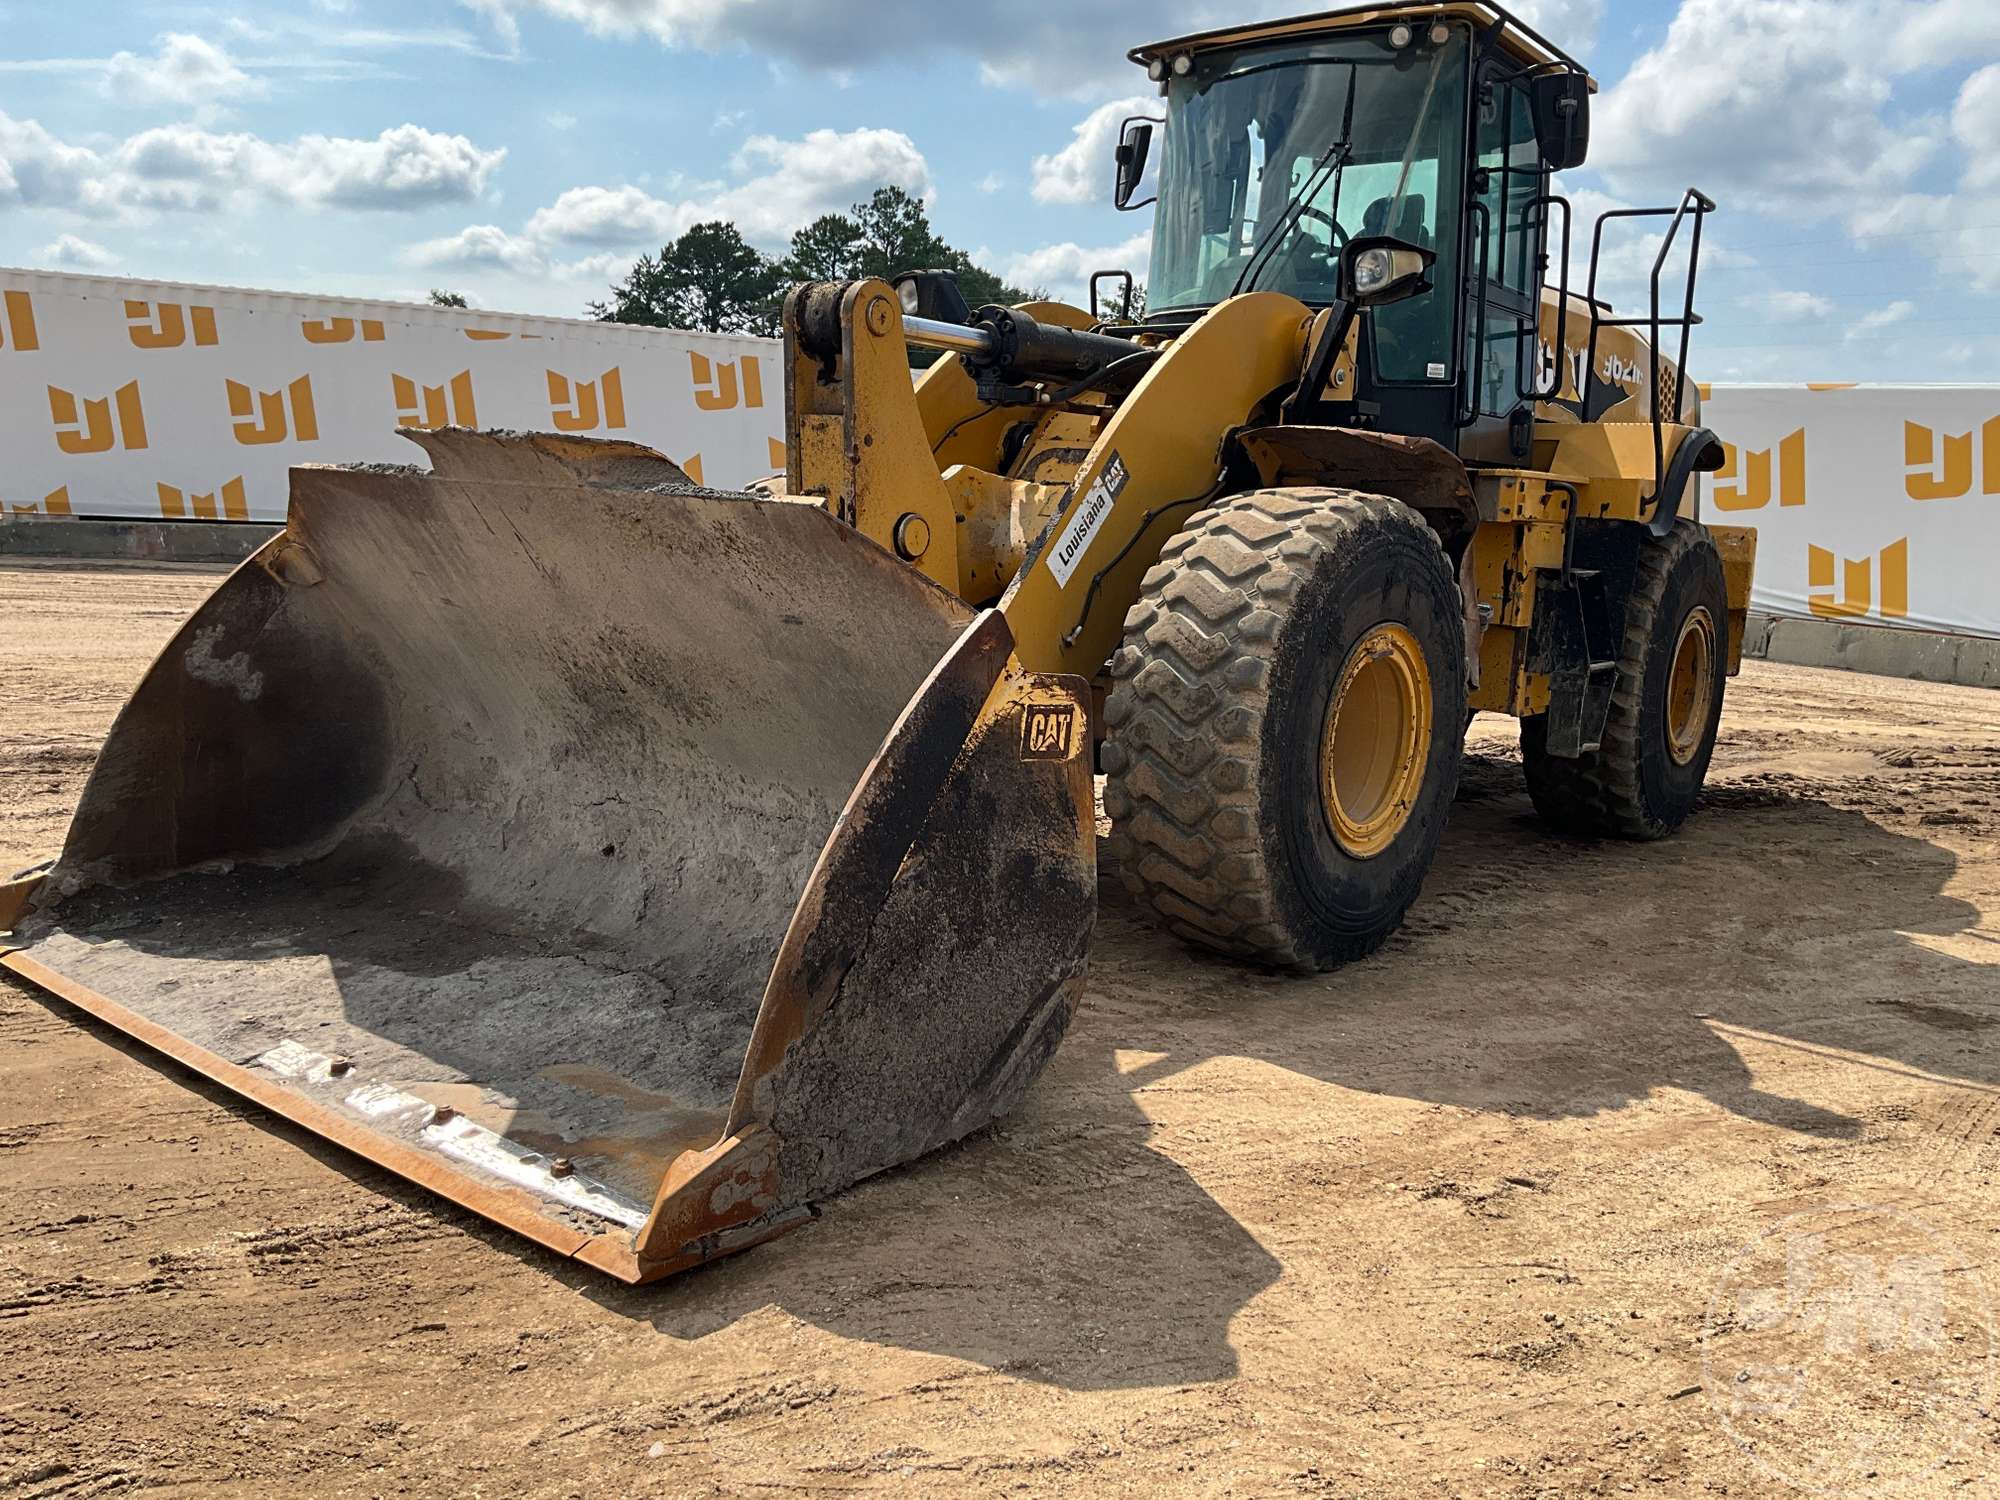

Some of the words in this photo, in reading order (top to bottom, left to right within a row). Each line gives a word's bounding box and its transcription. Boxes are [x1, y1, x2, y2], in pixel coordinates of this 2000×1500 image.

[1058, 494, 1106, 567] Louisiana
[1104, 459, 1125, 493] CAT
[1030, 713, 1071, 752] CAT
